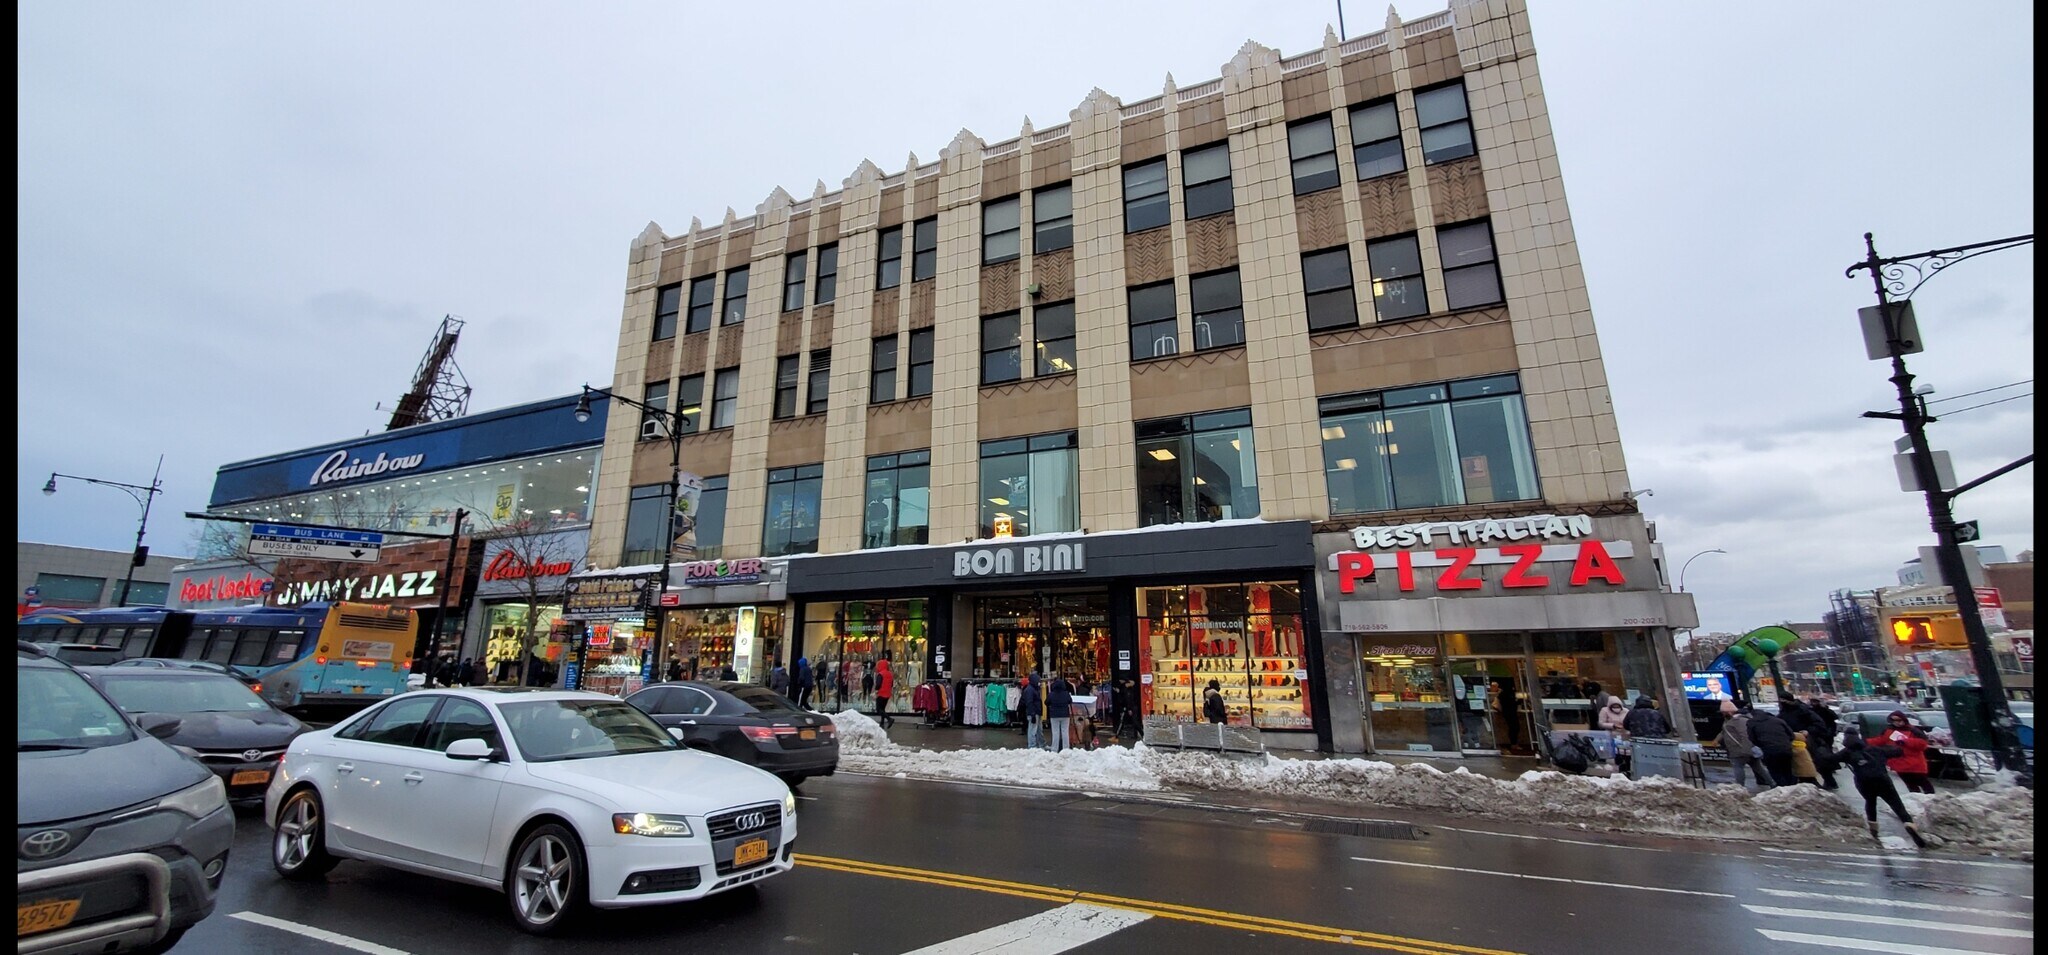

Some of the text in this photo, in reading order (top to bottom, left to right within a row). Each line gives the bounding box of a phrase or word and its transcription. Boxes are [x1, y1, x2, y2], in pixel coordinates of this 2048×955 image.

[310, 450, 424, 485] Rainbow
[294, 528, 345, 539] BUS LANE
[1353, 514, 1594, 549] BEST ITALIAN
[262, 541, 319, 552] BUSES ONLY
[685, 559, 762, 578] FOREVER
[954, 543, 1086, 577] BON BINI
[1337, 540, 1627, 594] PIZZA
[180, 577, 213, 602] Foot
[277, 570, 438, 606] JIMMY JAZZ
[1623, 617, 1656, 625] 200-202
[1371, 644, 1437, 655] Slice of Pizza
